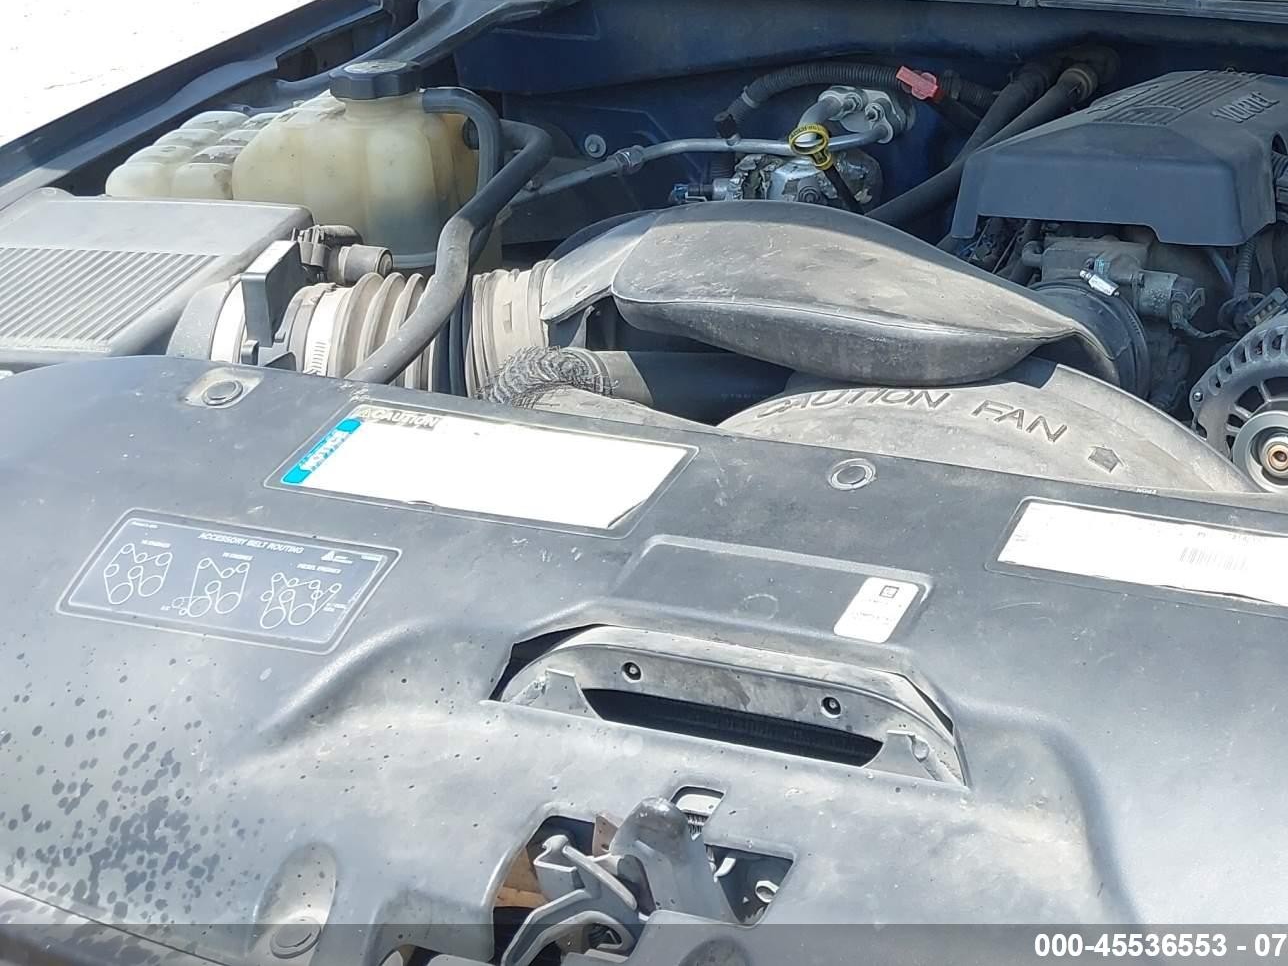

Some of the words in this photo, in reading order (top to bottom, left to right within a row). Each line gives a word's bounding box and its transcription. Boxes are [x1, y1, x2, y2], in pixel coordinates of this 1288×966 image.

[372, 409, 441, 430] CAUTION
[970, 399, 1069, 444] FAN
[198, 532, 248, 546] ACCESSORY
[246, 538, 269, 549] BELT
[267, 542, 304, 554] ROUTING
